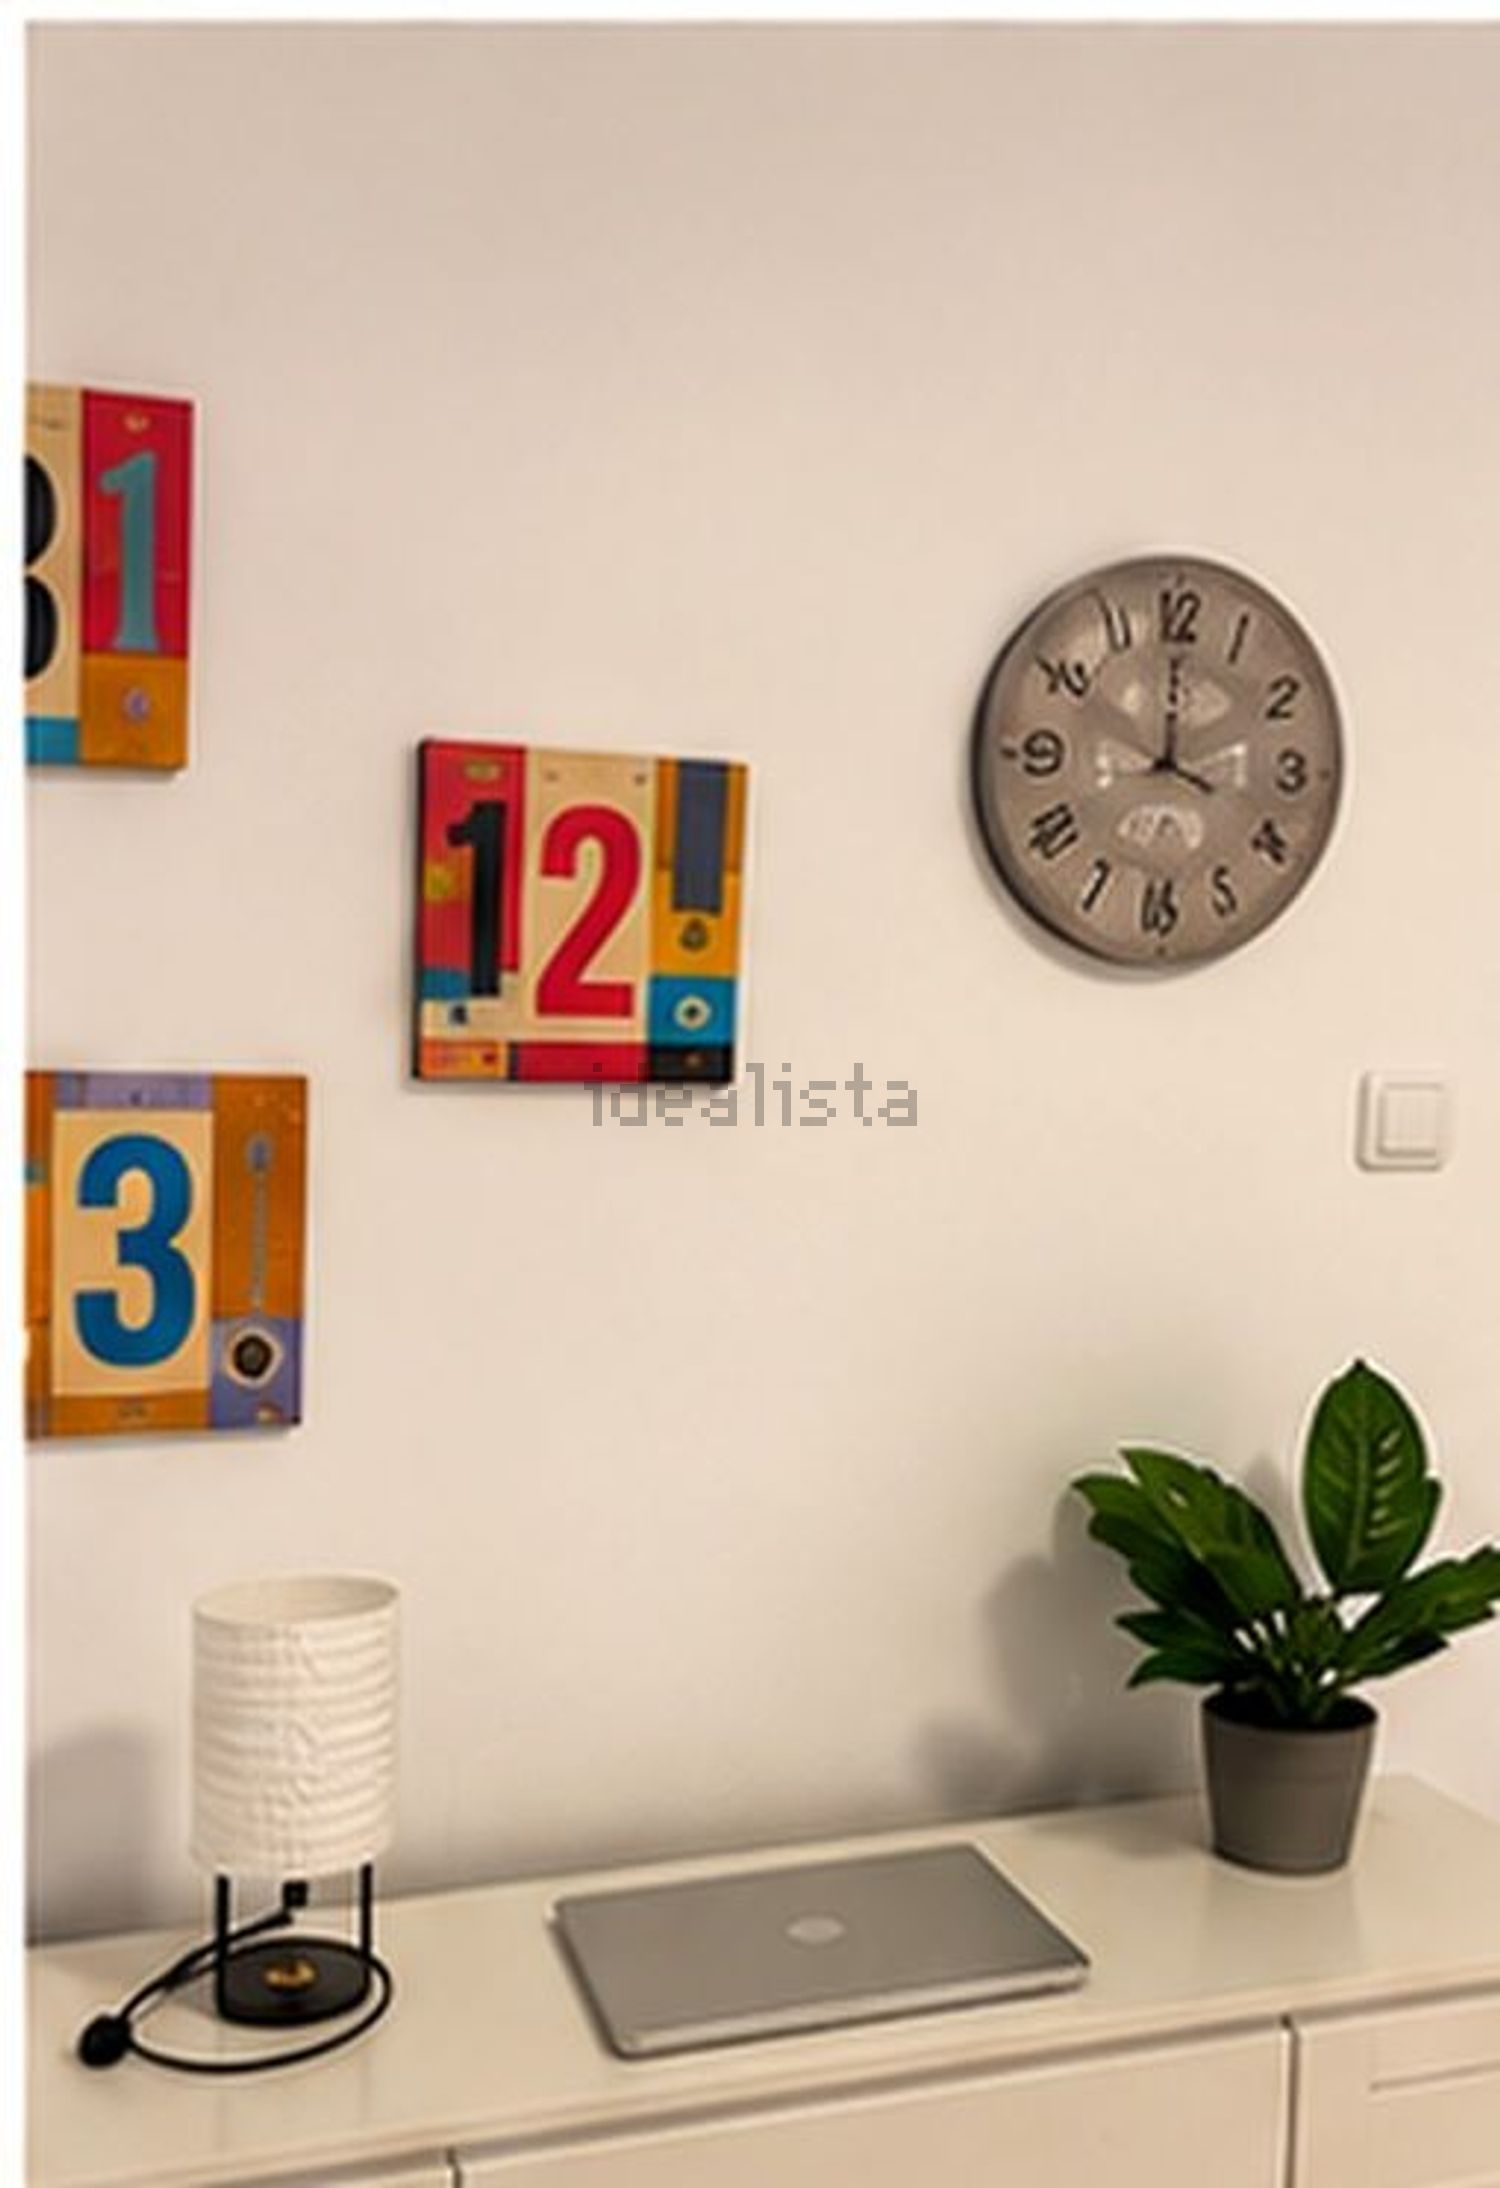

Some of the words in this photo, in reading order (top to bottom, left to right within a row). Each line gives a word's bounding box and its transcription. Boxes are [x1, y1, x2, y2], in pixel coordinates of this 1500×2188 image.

[1160, 591, 1201, 645] 12
[1265, 675, 1299, 720] 2
[1277, 749, 1307, 794] 3
[447, 802, 642, 1018] 12
[74, 1132, 197, 1367] 3
